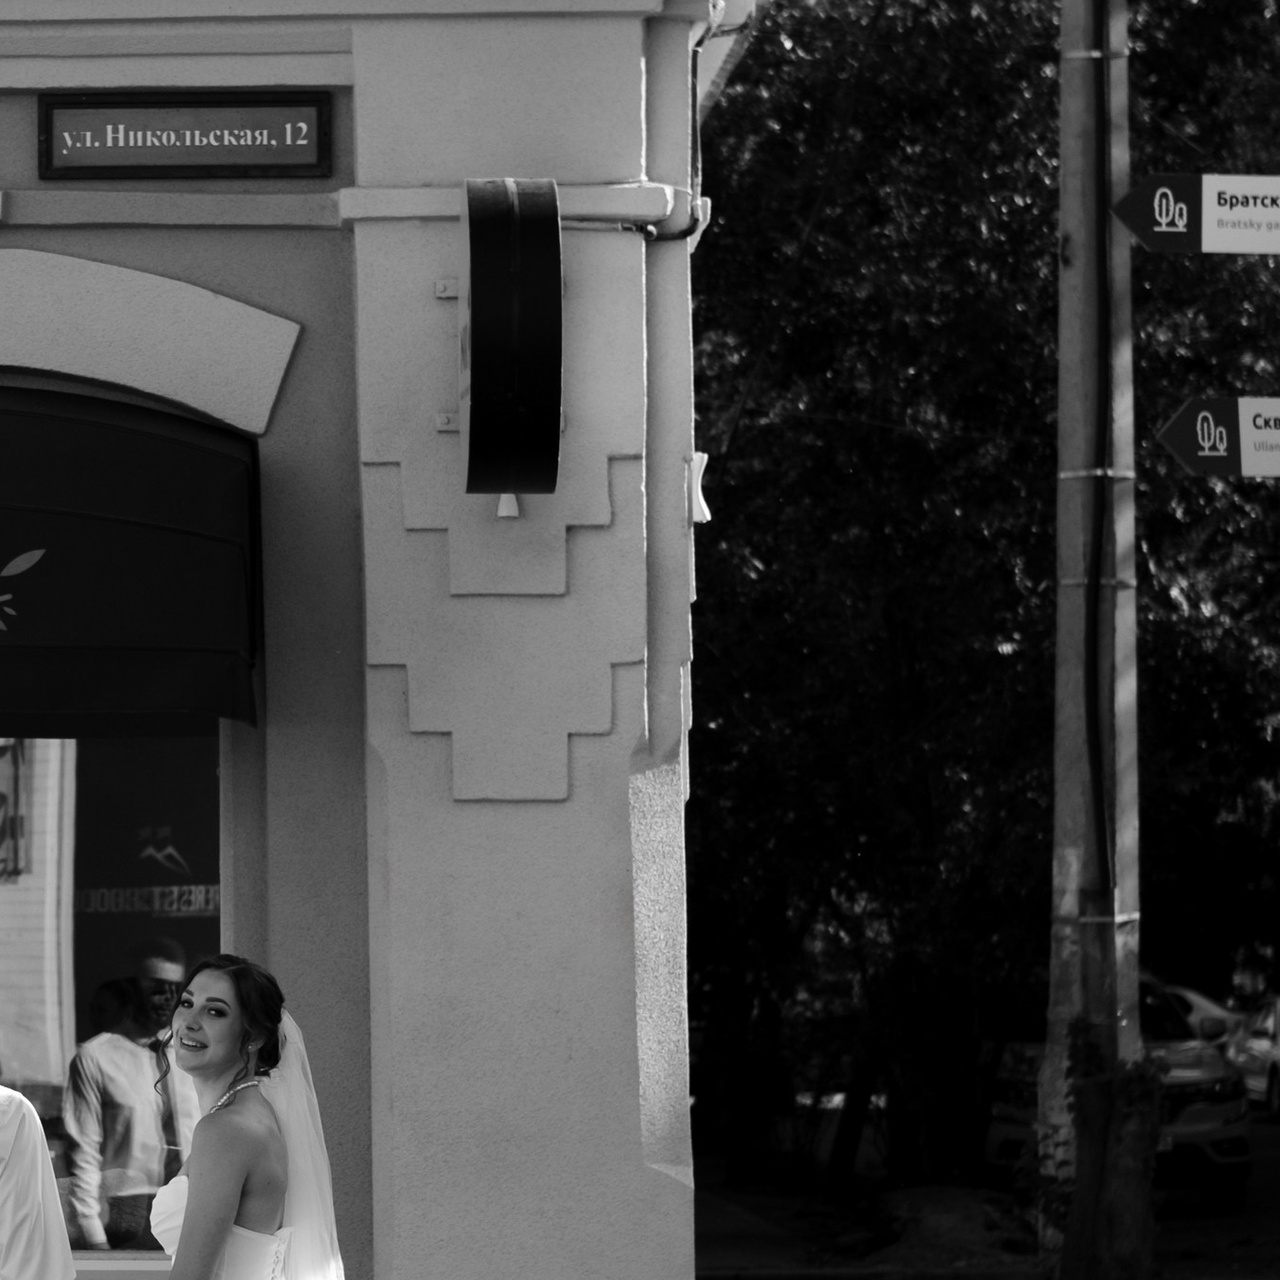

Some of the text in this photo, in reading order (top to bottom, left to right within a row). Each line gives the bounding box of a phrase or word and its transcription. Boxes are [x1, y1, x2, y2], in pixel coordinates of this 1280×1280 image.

[62, 122, 309, 154] ул. Никольская, 12
